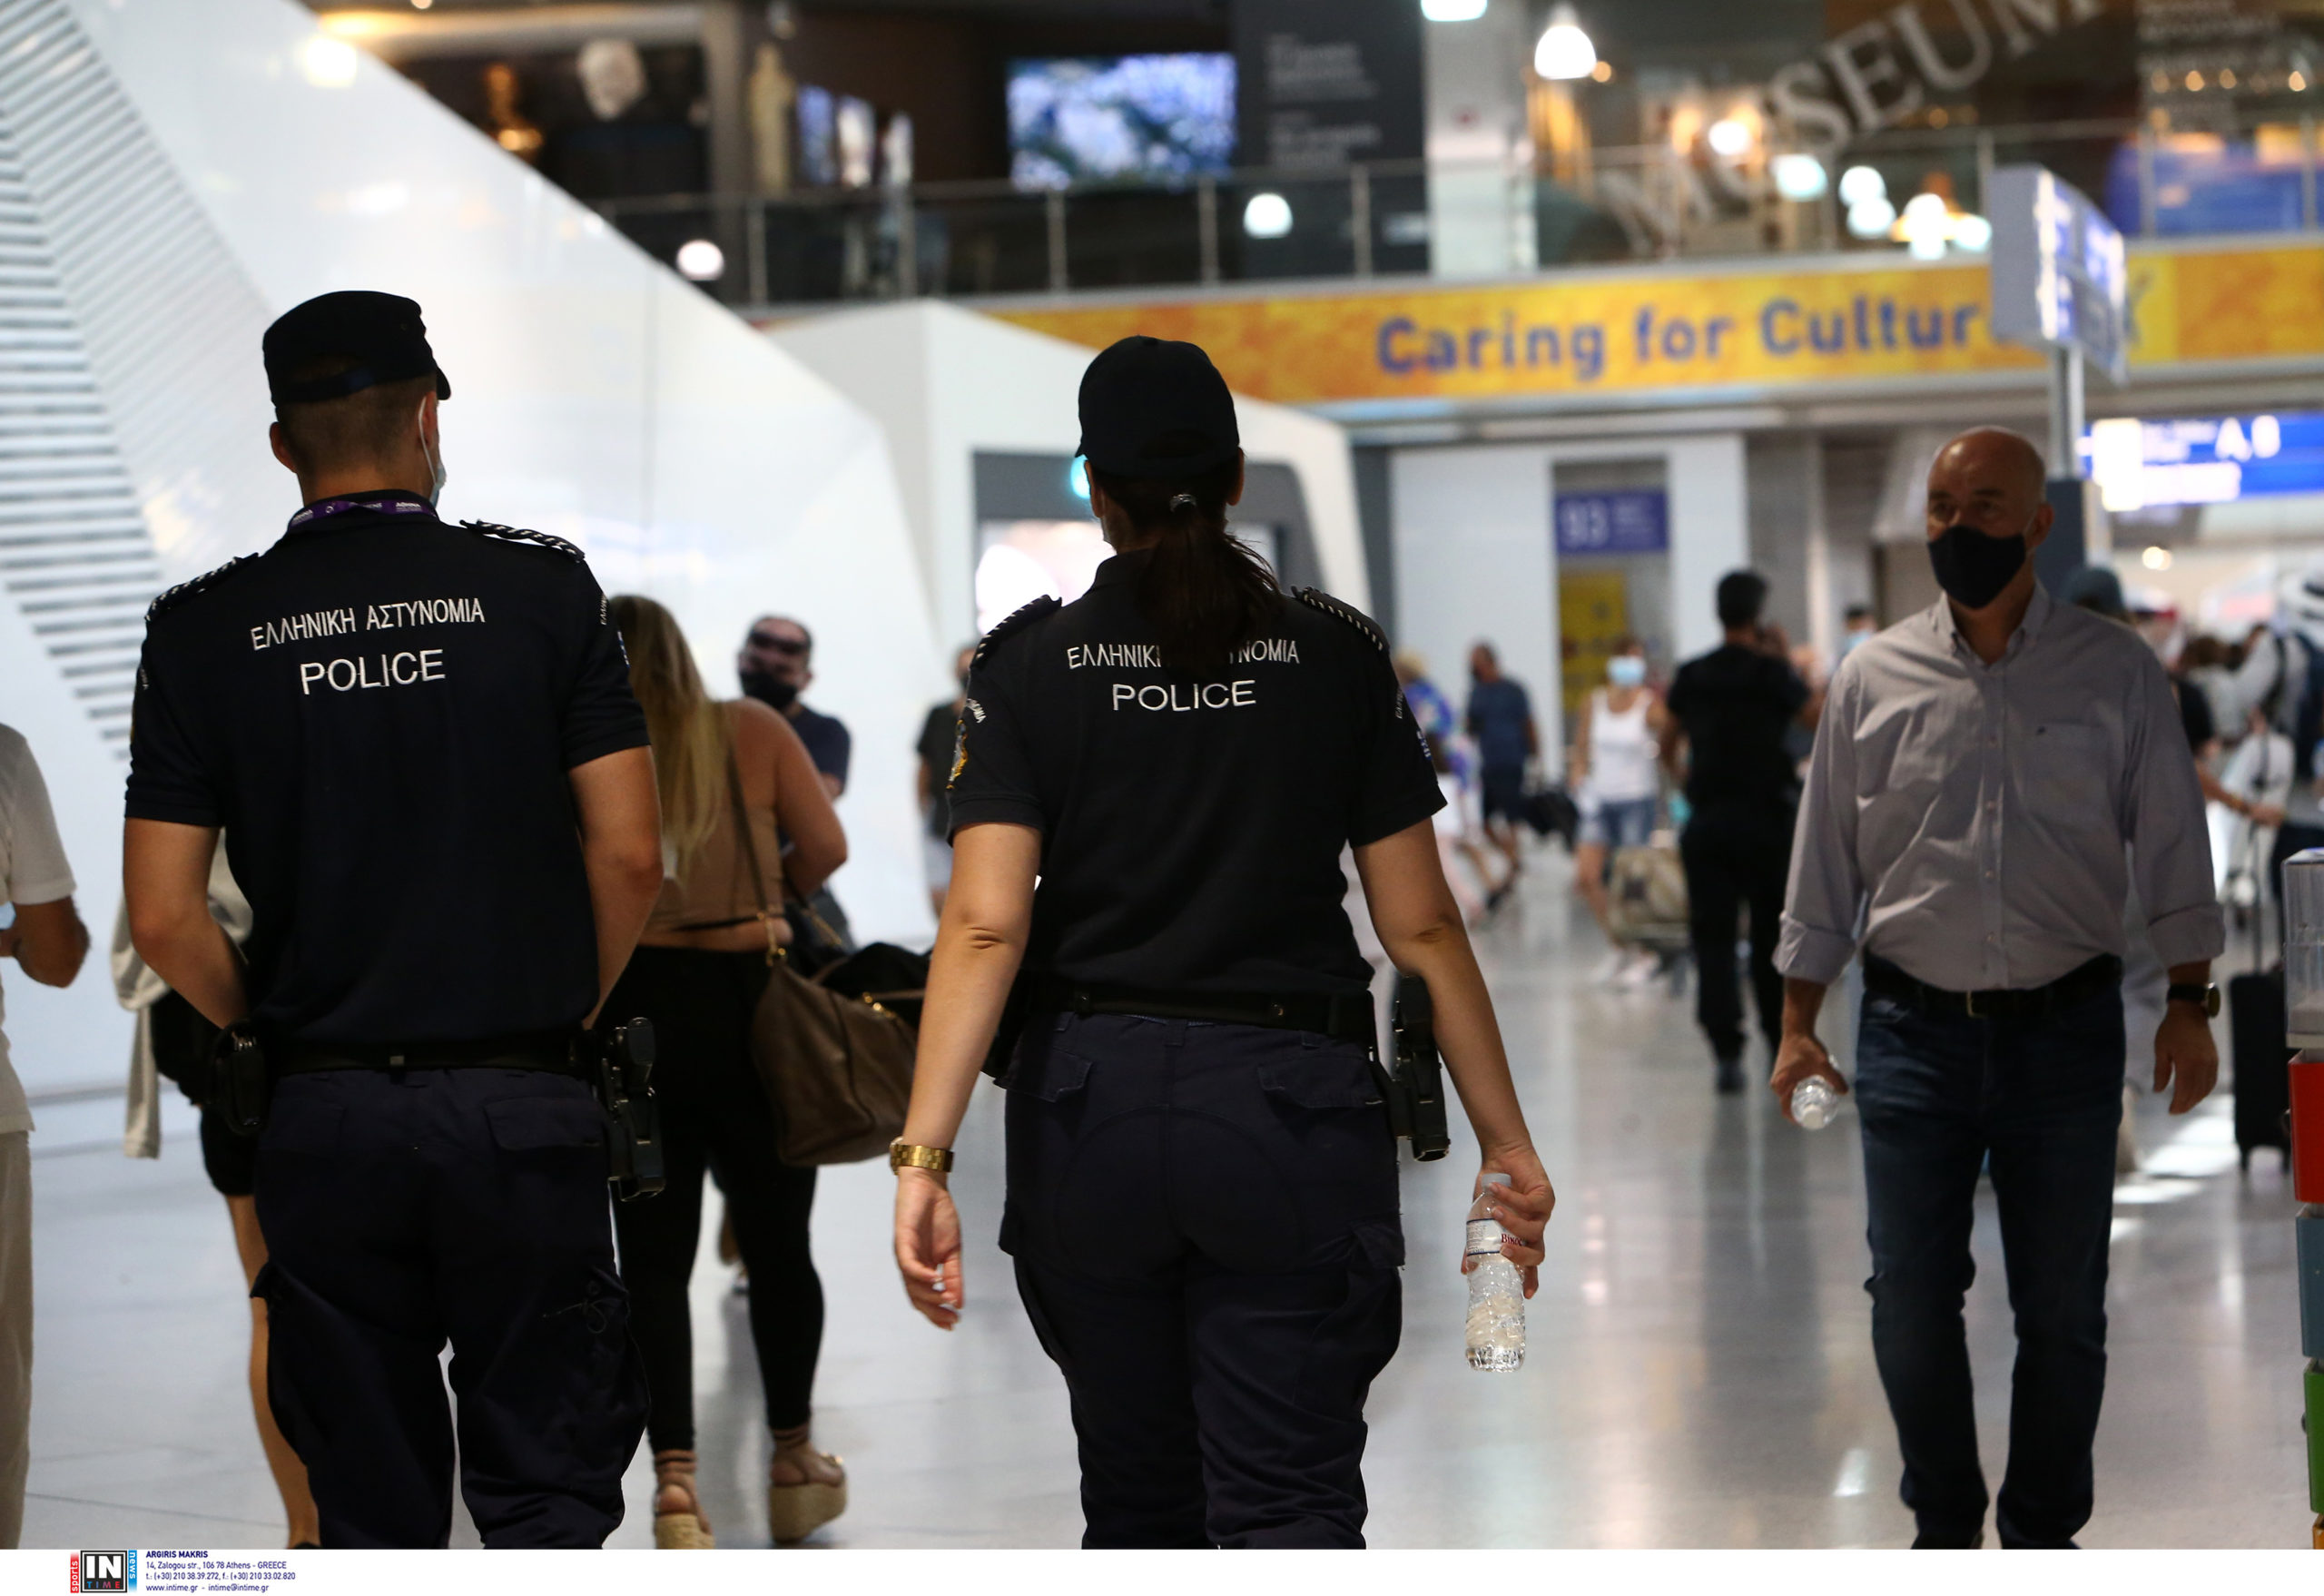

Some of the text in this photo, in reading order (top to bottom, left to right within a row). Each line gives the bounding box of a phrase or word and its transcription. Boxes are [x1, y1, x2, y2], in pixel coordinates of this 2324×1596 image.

[1377, 292, 1981, 382] Caring for Cultur
[251, 598, 485, 650] ΕΛΛΗΝΙΚΗ ΑΣΤΥΝΟΜΙΑ
[300, 649, 445, 695] POLICE
[1230, 639, 1300, 664] ΝΟΜΙΑ
[1113, 680, 1256, 711] POLICE
